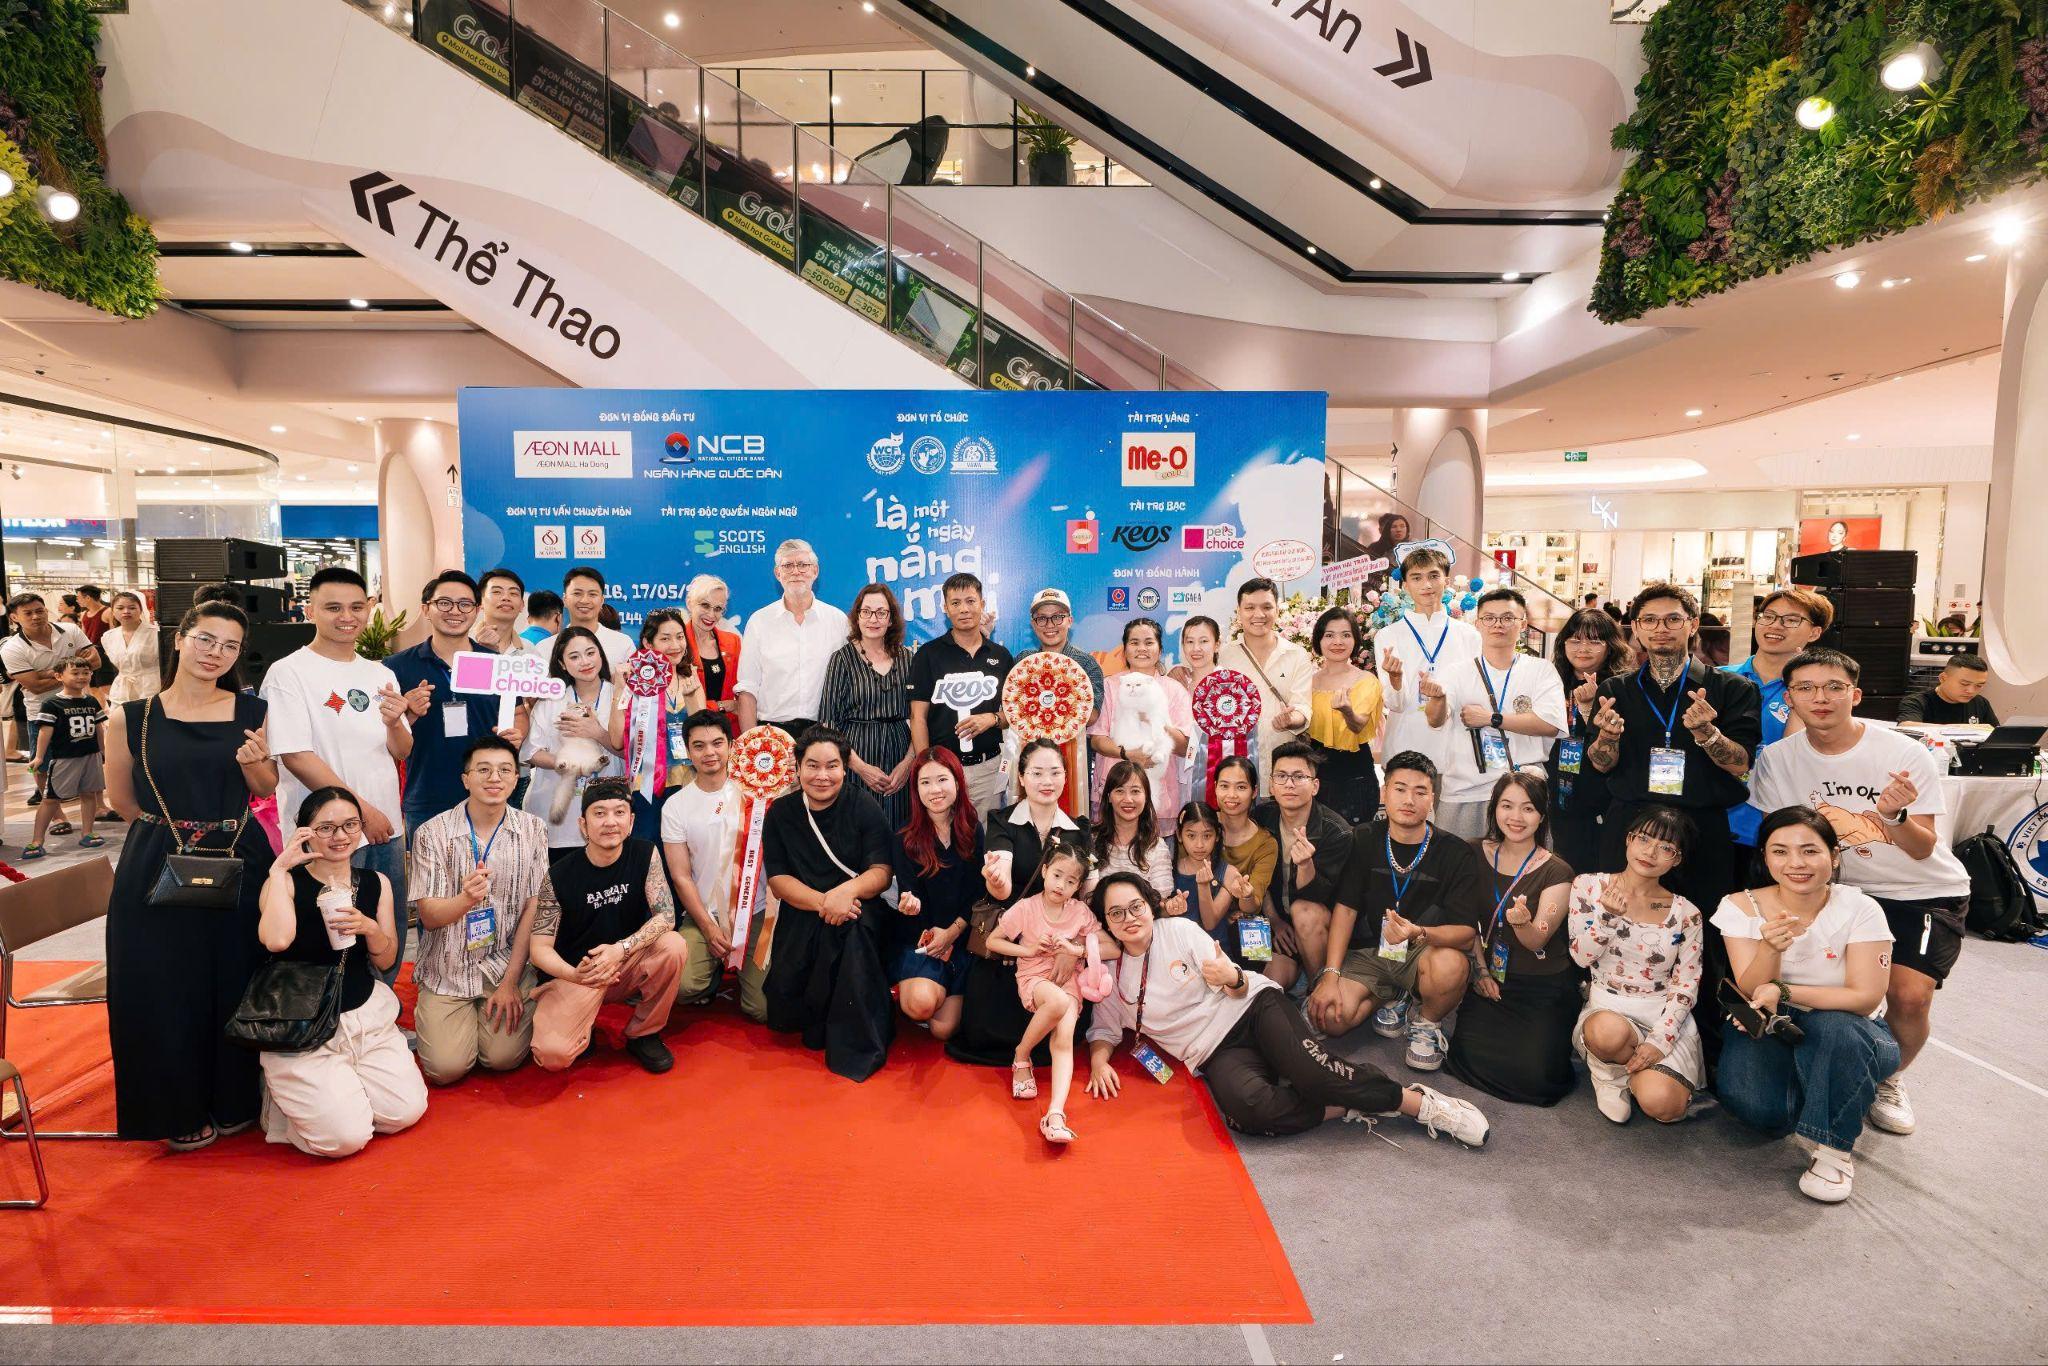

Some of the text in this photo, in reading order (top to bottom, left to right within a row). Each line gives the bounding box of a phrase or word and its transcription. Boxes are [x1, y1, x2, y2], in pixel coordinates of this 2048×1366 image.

[448, 39, 465, 55] Mall
[465, 48, 479, 62] hot
[478, 56, 497, 74] Grab
[733, 216, 750, 231] Mall
[750, 224, 764, 239] hot
[763, 234, 782, 251] Grab
[820, 240, 843, 258] AEON
[414, 200, 621, 360] Thể Thao
[621, 412, 631, 423] VỊ
[919, 413, 929, 424] VỊ
[1165, 410, 1190, 423] VÀNG
[573, 440, 621, 456] MALL
[697, 435, 765, 454] NCB
[873, 445, 899, 454] WCF
[556, 460, 577, 468] MALL
[1128, 445, 1188, 471] Me-O
[643, 466, 783, 479] NGÂN HÀNG QUỐC DÂN
[1161, 469, 1183, 480] GOLD
[528, 506, 538, 518] VỊ
[875, 494, 950, 531] là một
[718, 530, 766, 543] SCOTS
[927, 519, 976, 543] ngày
[719, 544, 766, 554] ENGLISH
[1205, 537, 1245, 549] choice
[903, 572, 1000, 622] mi
[497, 658, 544, 676] pet's
[495, 673, 562, 695] choice
[69, 715, 96, 738] 86
[1822, 781, 1853, 796] I'm
[2022, 822, 2038, 838] VIET
[747, 850, 755, 868] BEST
